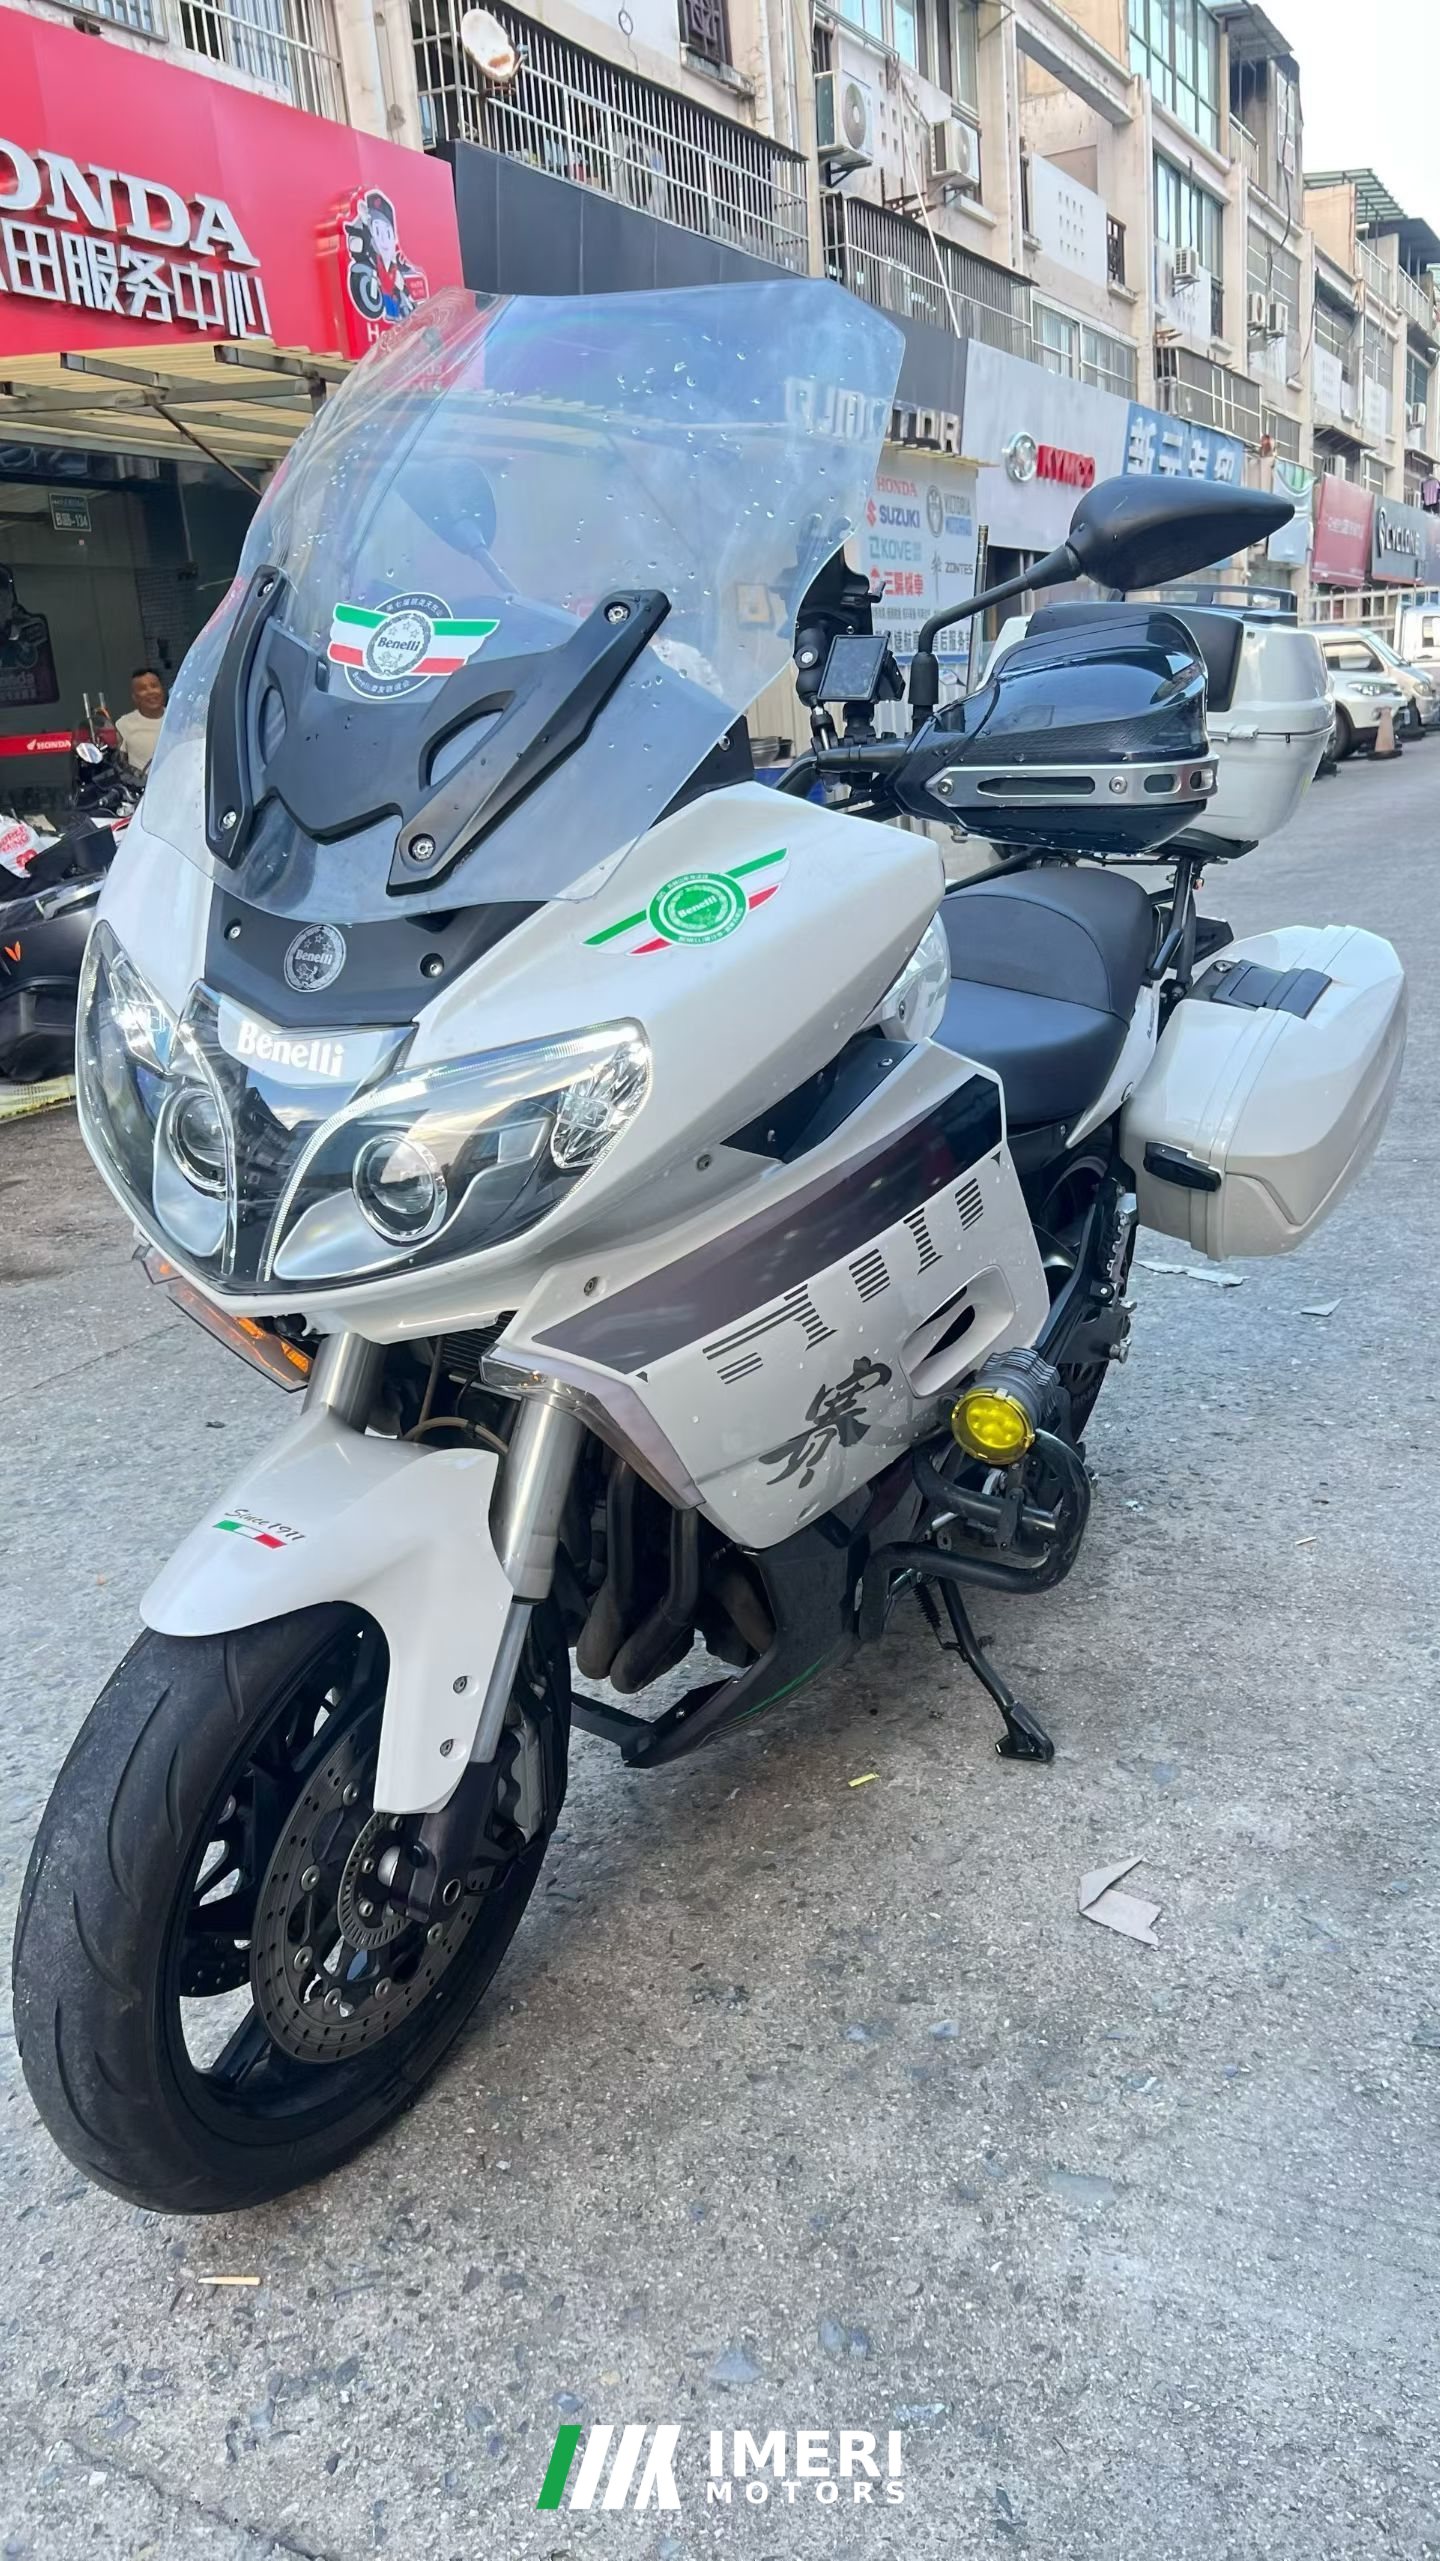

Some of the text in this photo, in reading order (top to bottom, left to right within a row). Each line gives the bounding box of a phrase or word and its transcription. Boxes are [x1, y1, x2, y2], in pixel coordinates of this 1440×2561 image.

[0, 219, 272, 340] 田服务中心
[876, 477, 919, 497] HONDA
[879, 504, 920, 529] SUZUKI
[377, 636, 420, 652] Benelli
[36, 739, 72, 751] HONDA
[678, 895, 718, 919] Benelli
[295, 949, 333, 965] Benelli
[237, 1019, 346, 1078] Benelli
[224, 1508, 306, 1541] Since 1911
